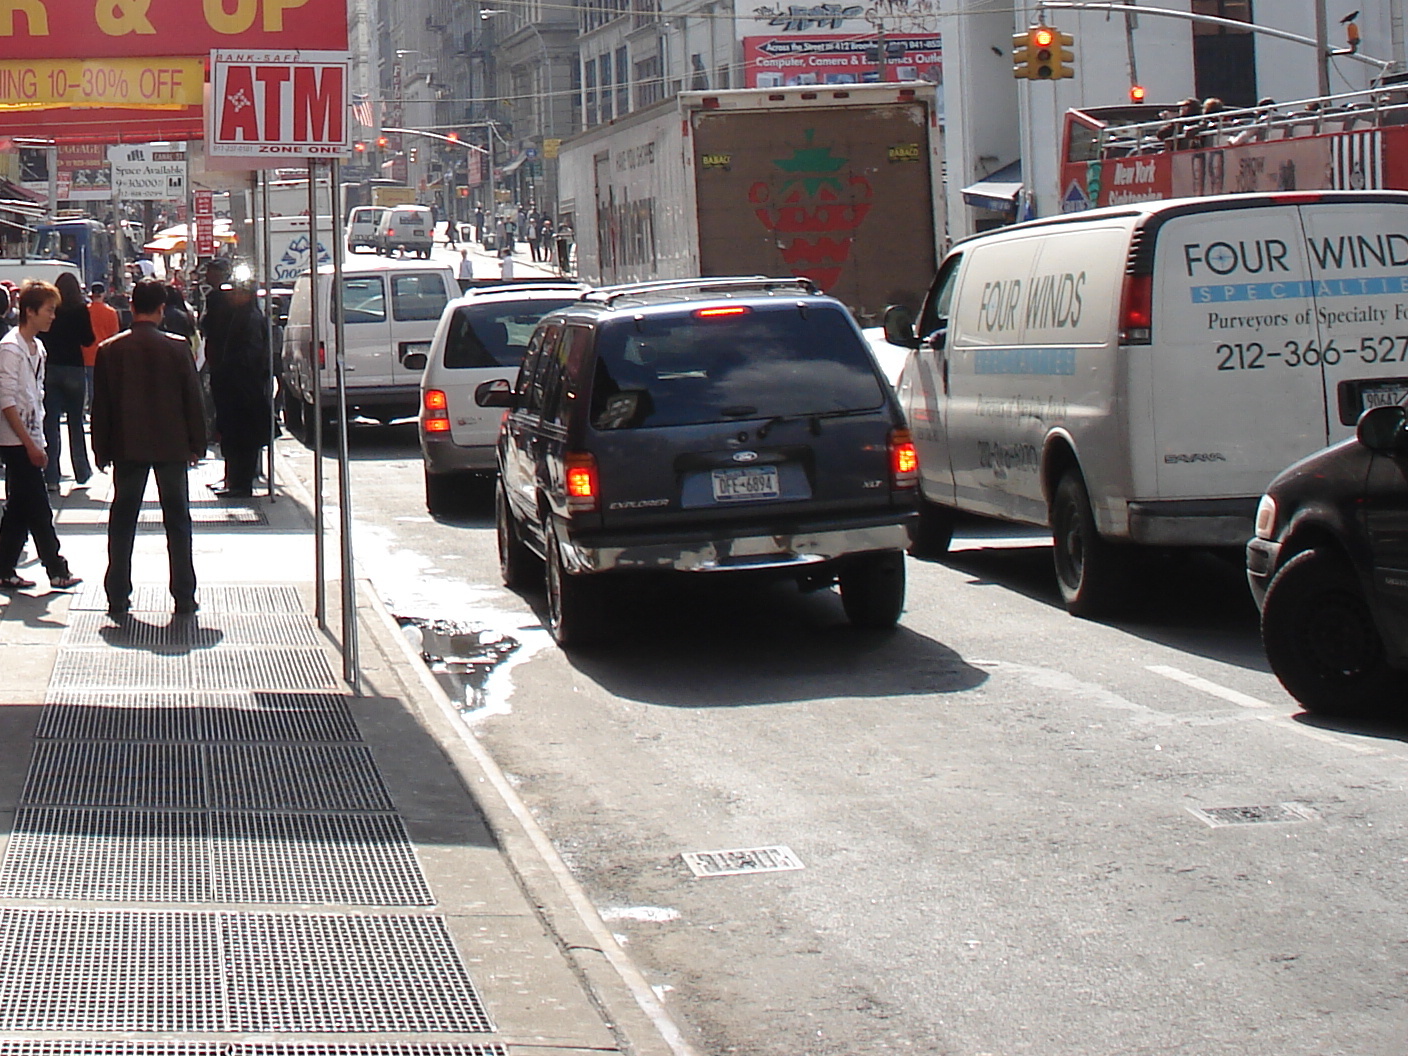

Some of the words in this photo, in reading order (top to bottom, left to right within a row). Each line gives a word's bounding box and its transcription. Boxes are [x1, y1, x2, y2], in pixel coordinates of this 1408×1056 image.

[755, 56, 807, 69] Computer,
[808, 55, 848, 66] Camera
[850, 55, 859, 66] &
[139, 68, 184, 98] OFF
[219, 66, 342, 142] ATM
[57, 145, 100, 155] UGGAGE
[259, 145, 303, 154] ZONE
[308, 146, 342, 154] ONE
[115, 165, 141, 177] Space
[143, 165, 184, 175] Available
[1114, 163, 1134, 186] New
[1135, 159, 1156, 185] York
[1184, 240, 1290, 276] FOUR
[978, 279, 1022, 332] FOUR
[1025, 271, 1086, 330] WINDS
[1207, 312, 1288, 332] Purveyors
[1295, 308, 1312, 324] of
[1317, 305, 1388, 329] Specialty
[609, 499, 670, 511] EXPLORER
